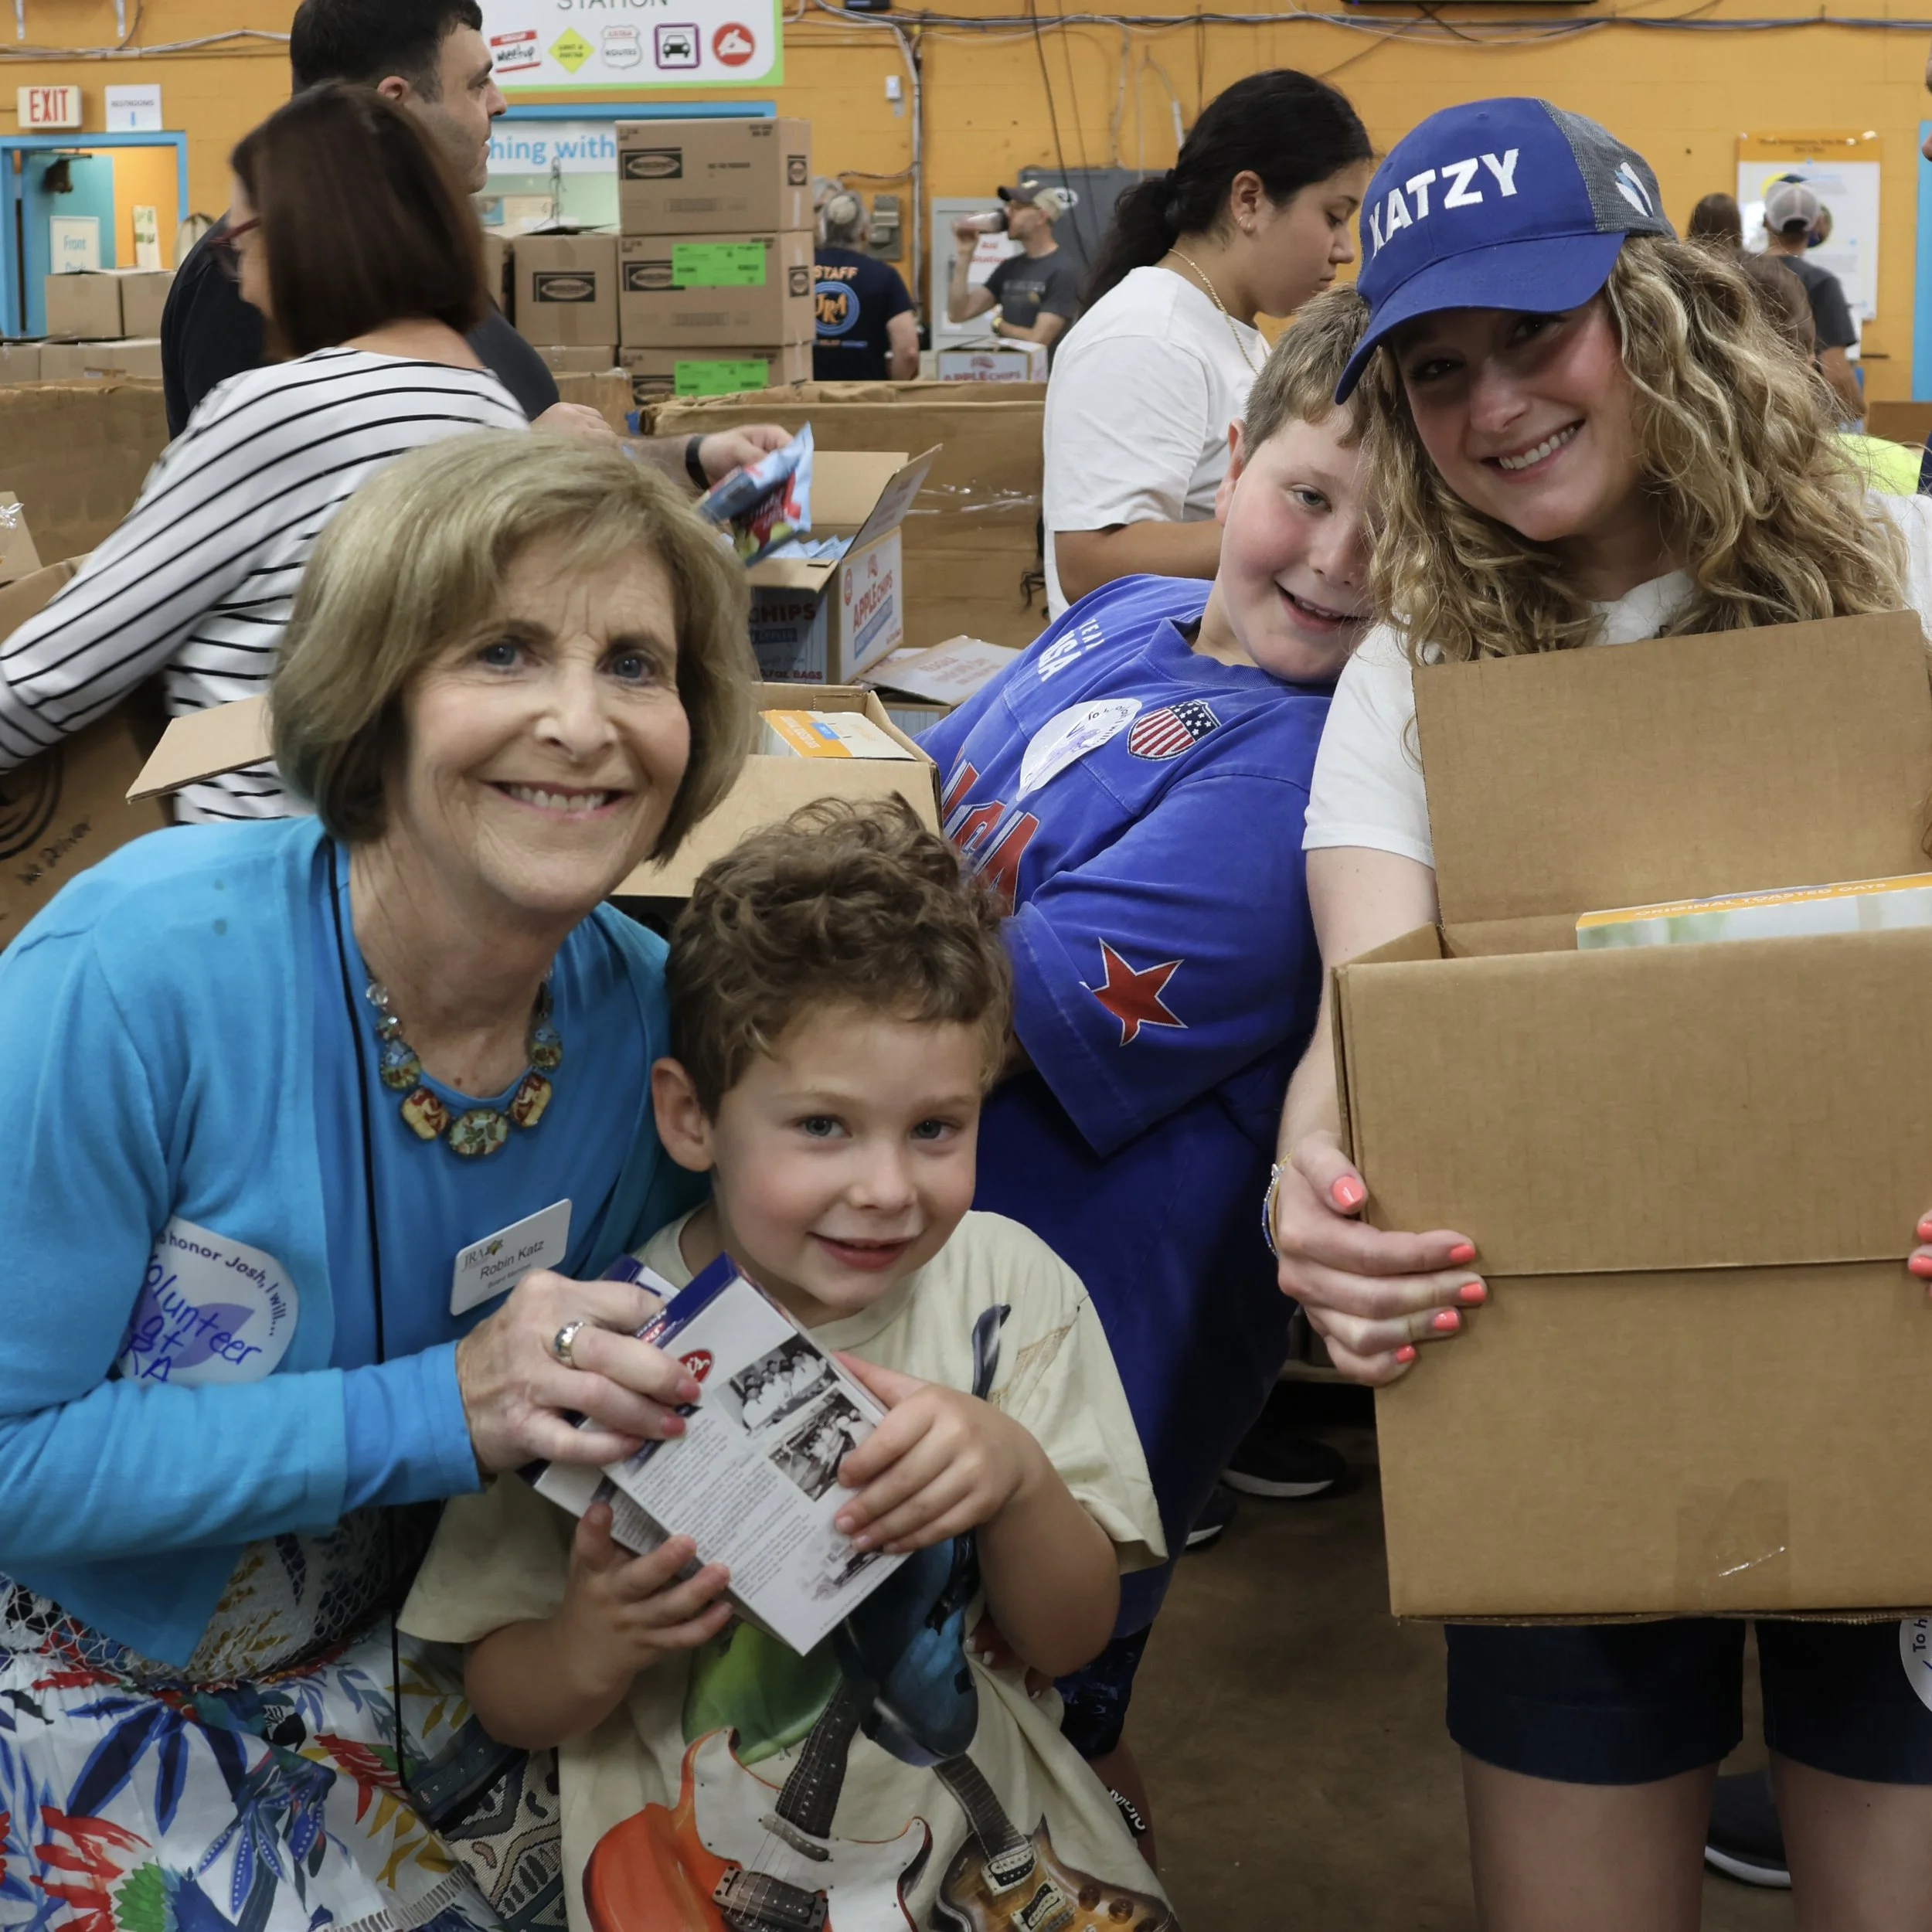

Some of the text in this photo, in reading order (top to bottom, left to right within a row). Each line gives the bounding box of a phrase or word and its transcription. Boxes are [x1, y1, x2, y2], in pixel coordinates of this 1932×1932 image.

[29, 89, 68, 122] EXIT
[555, 134, 615, 158] with
[1369, 148, 1519, 260] KATZY
[63, 235, 87, 250] Front
[814, 265, 859, 279] STAFF
[749, 603, 816, 623] CHIPS
[1038, 629, 1082, 682] USA
[793, 670, 823, 679] BAGS
[1634, 883, 1886, 916] ORIGINAL TOASTED OATS
[168, 1232, 222, 1260] honor
[225, 1257, 266, 1289] Josh,
[480, 1240, 545, 1280] Robin Katz
[146, 1254, 262, 1366] olunteer
[1913, 1633, 1926, 1652] To
